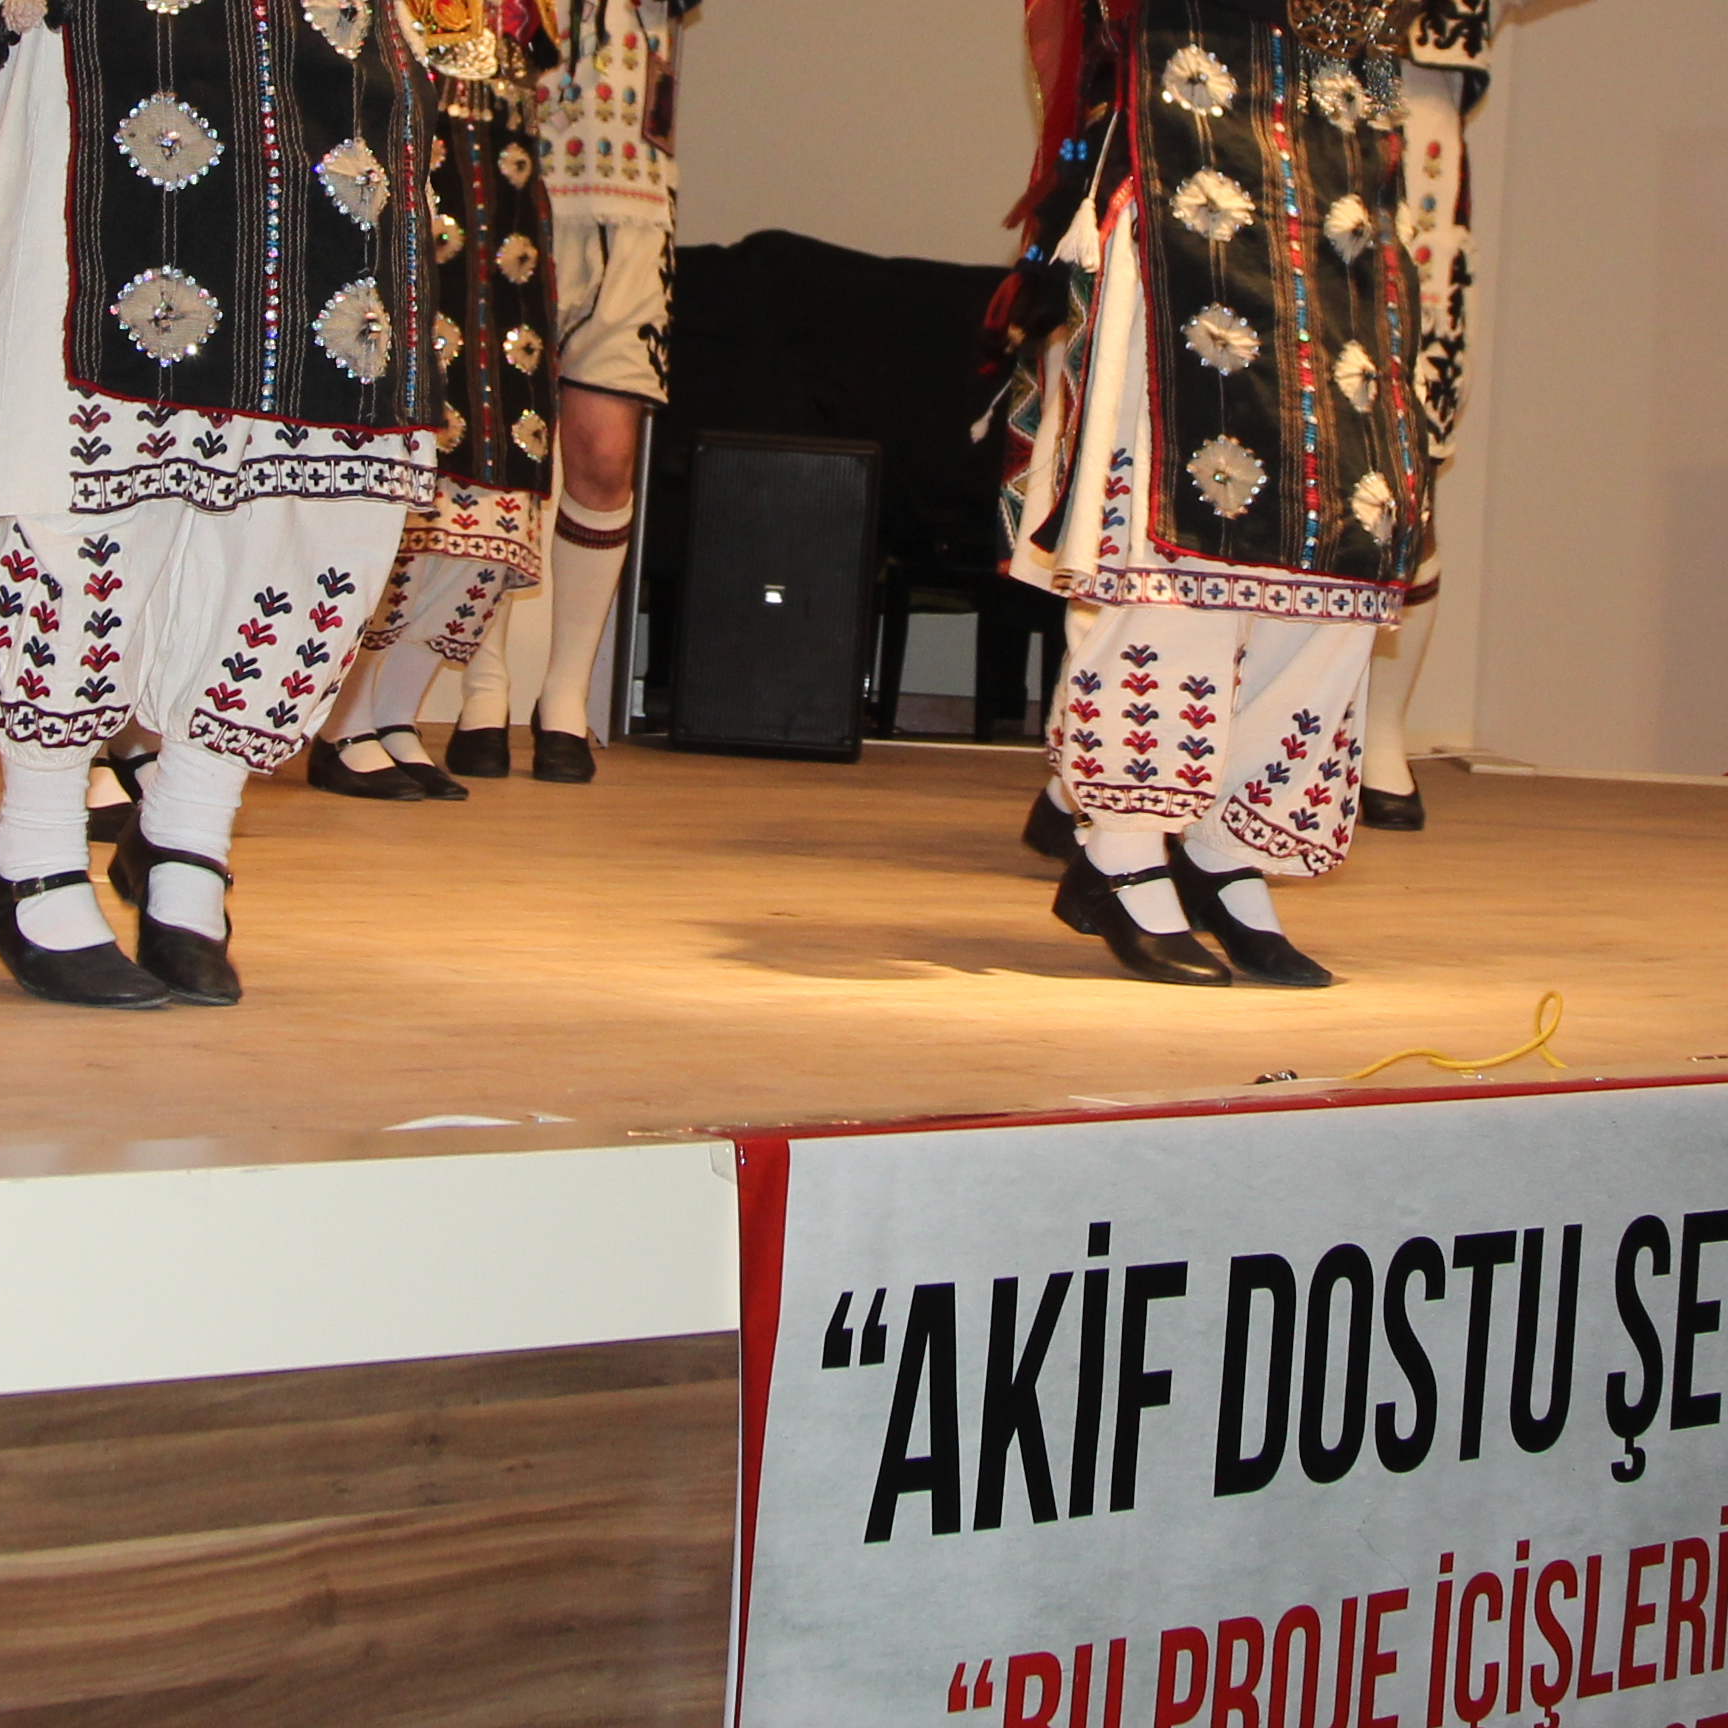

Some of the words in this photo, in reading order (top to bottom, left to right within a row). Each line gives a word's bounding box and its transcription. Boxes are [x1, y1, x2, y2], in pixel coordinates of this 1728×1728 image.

[822, 1222, 1187, 1543] “AKİF
[1214, 1225, 1582, 1497] DOSTU
[1154, 1589, 1408, 1728] PROJE
